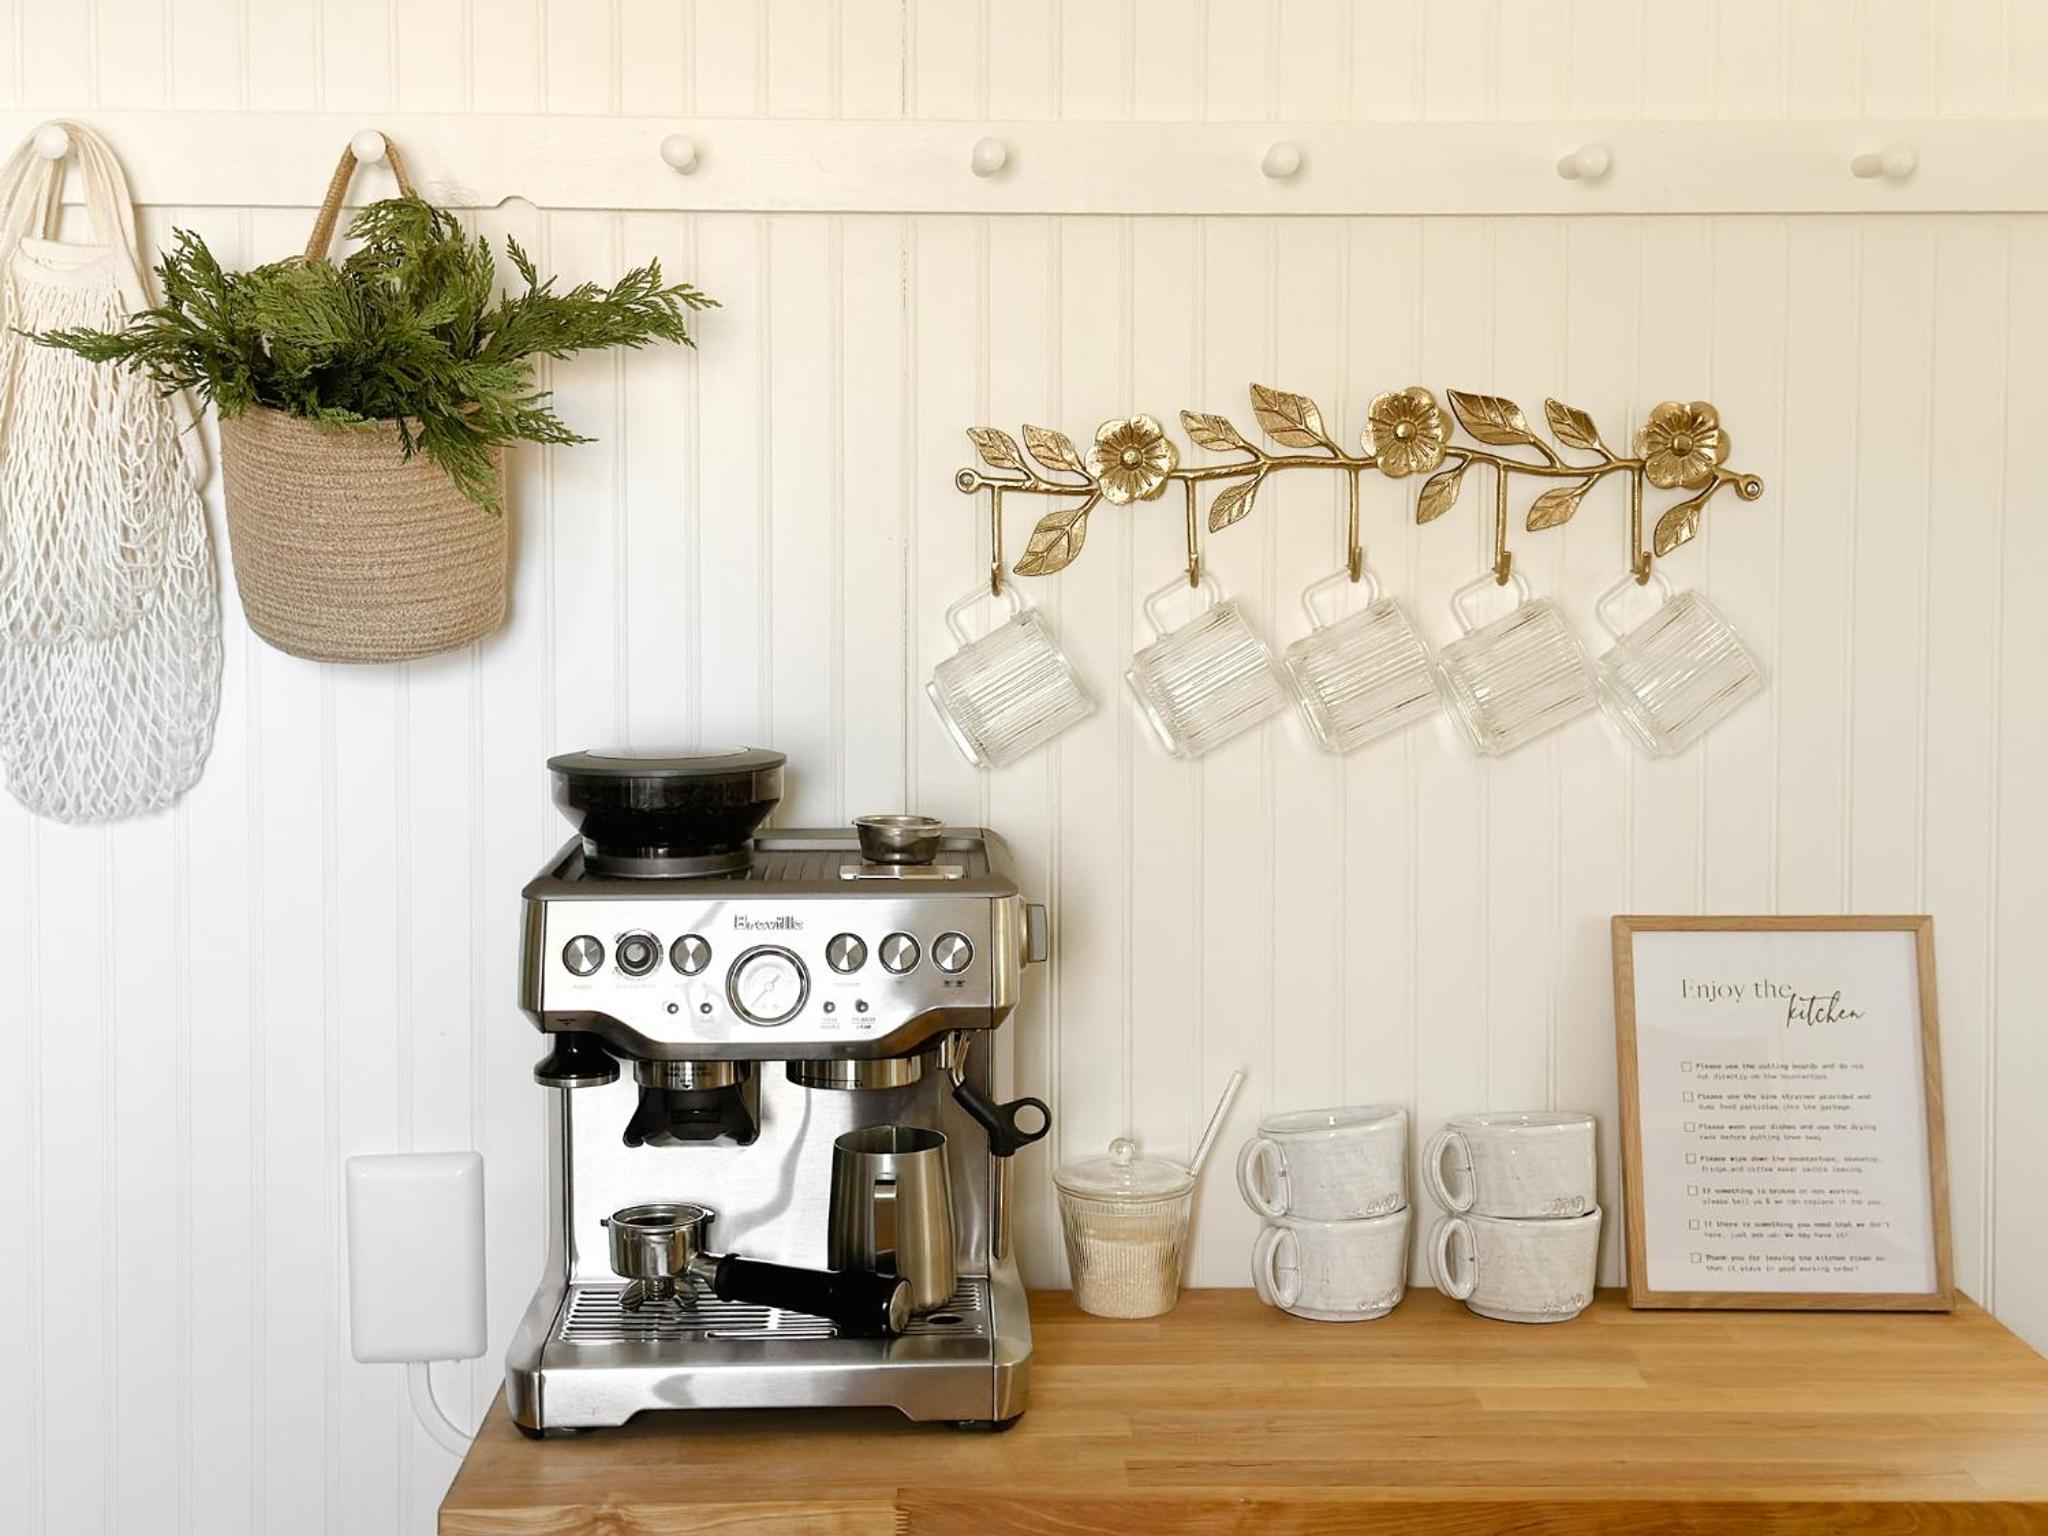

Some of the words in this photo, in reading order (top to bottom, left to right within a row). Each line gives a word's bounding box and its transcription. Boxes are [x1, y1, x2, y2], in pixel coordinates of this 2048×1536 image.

[734, 914, 804, 931] Breville
[1682, 979, 1745, 1003] Enjoy
[1754, 979, 1793, 999] the
[1786, 990, 1867, 1028] kitchen
